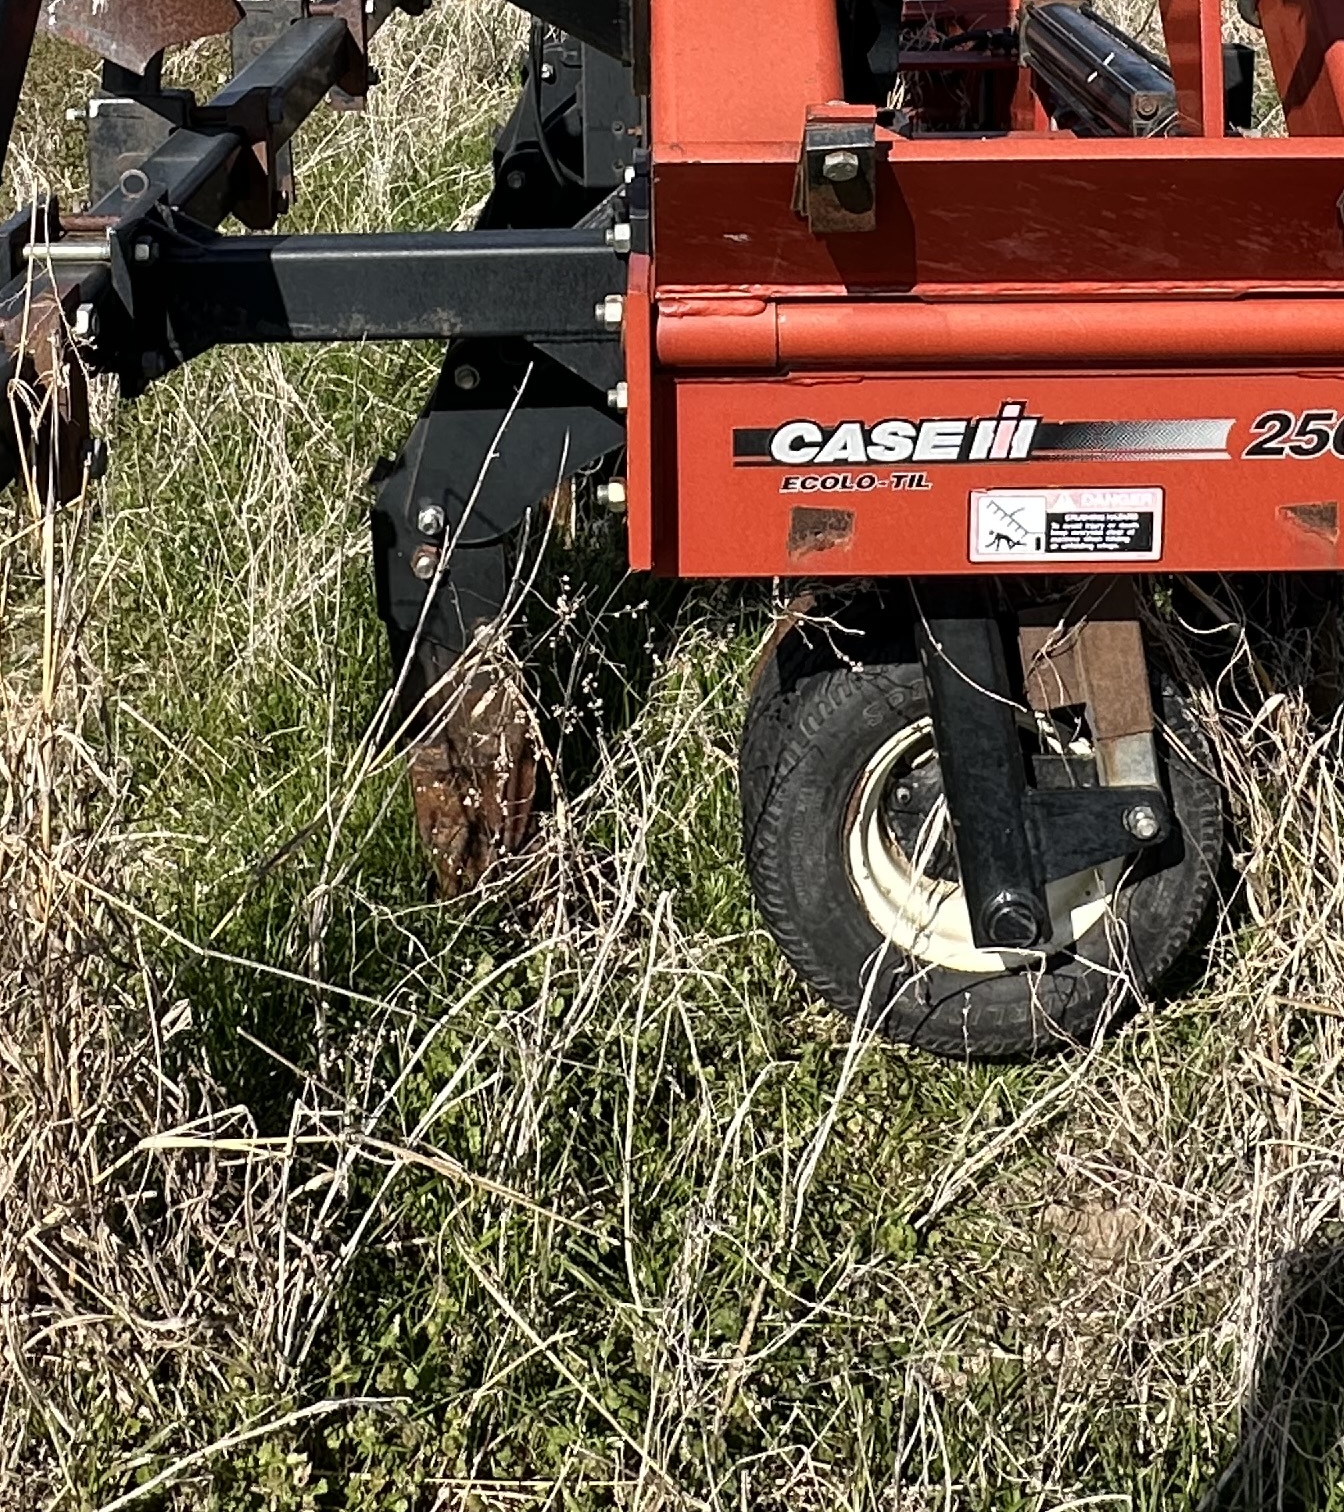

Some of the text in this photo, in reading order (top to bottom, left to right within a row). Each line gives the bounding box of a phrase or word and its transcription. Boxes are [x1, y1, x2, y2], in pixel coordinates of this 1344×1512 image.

[769, 419, 971, 464] CASE
[781, 473, 931, 492] ECOLO-TIL
[1080, 492, 1153, 508] DANGER
